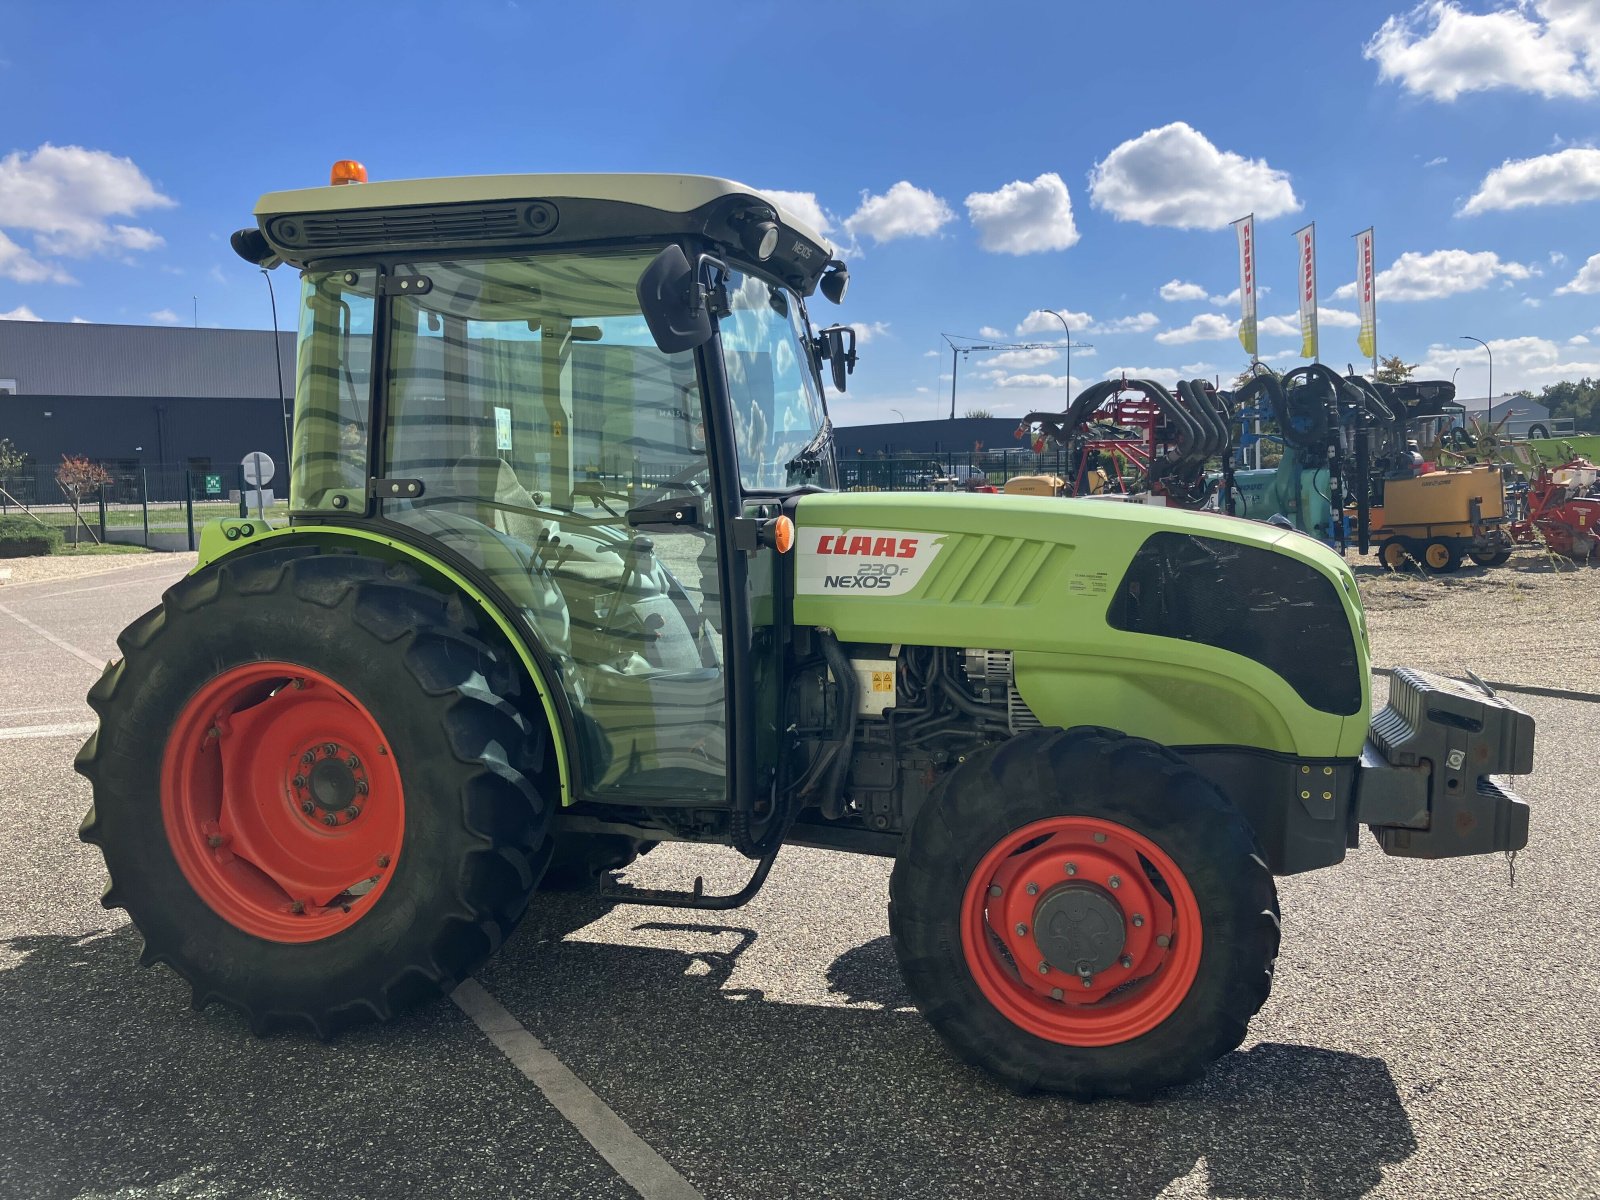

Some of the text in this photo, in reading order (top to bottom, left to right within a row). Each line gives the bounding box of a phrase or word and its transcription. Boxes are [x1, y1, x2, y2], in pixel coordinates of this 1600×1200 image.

[791, 240, 813, 260] NEXOS
[816, 535, 919, 559] CLAAS
[823, 575, 892, 589] NEXOS
